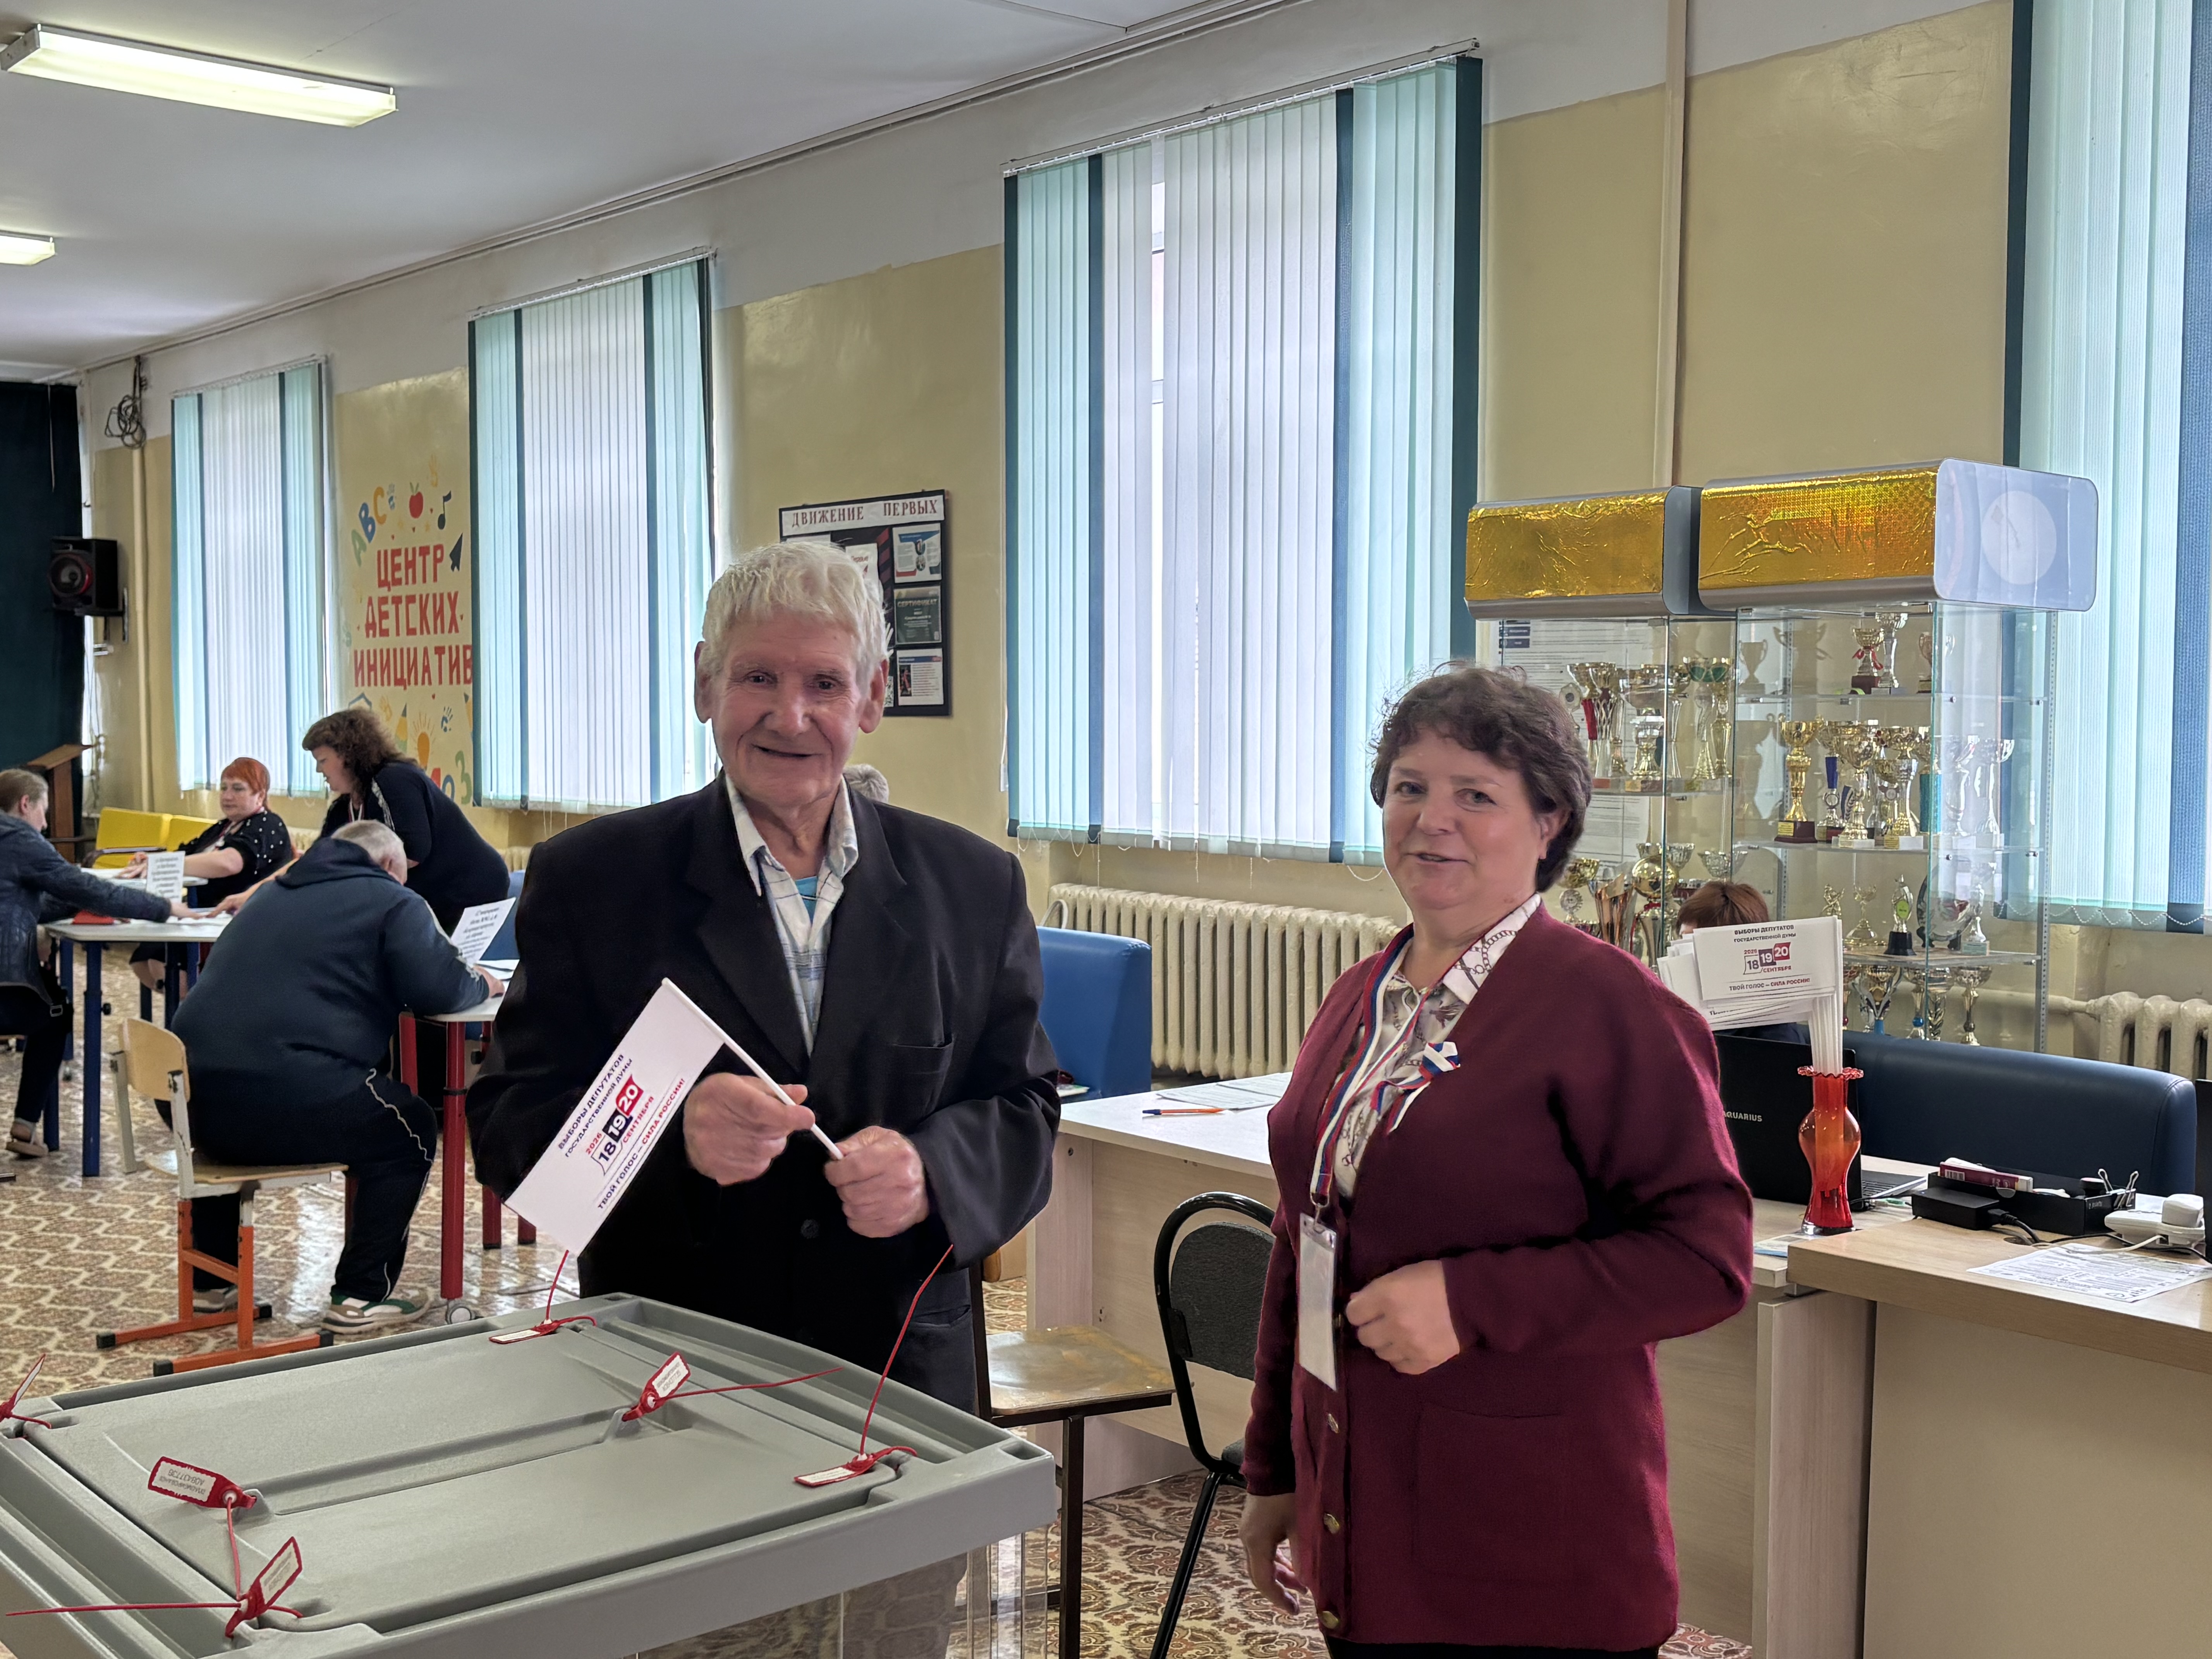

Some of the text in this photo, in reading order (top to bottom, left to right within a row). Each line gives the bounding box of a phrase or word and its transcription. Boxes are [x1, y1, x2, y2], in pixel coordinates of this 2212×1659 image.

[792, 500, 938, 527] ДВИЖЕНИЕ ПЕРВЫХ
[377, 544, 445, 592] ЦЕНТР
[365, 591, 460, 638] ДЕТСКИХ
[354, 644, 472, 690] ИНИЦИАТИВ
[1734, 934, 1781, 942] ГОСУДАРСТВЕННОЙ
[1761, 925, 1794, 933] ДЕПУТАТОВ
[1747, 946, 1788, 970] 18 19 20
[558, 1054, 624, 1149] ВЫБОРЫ ДЕПУТАТОВ
[565, 1058, 632, 1157] ГОСУДАРСТВЕННОЙ ДУМЫ
[599, 1084, 639, 1162] 18 19 20
[623, 1096, 654, 1143] СЕНТЯБРЯ
[586, 1132, 603, 1154] 2026
[598, 1185, 617, 1209] ТВОЙ
[616, 1153, 638, 1185] ГОЛОС
[642, 1120, 659, 1145] СИЛА
[659, 1078, 685, 1118] РОССИИ!
